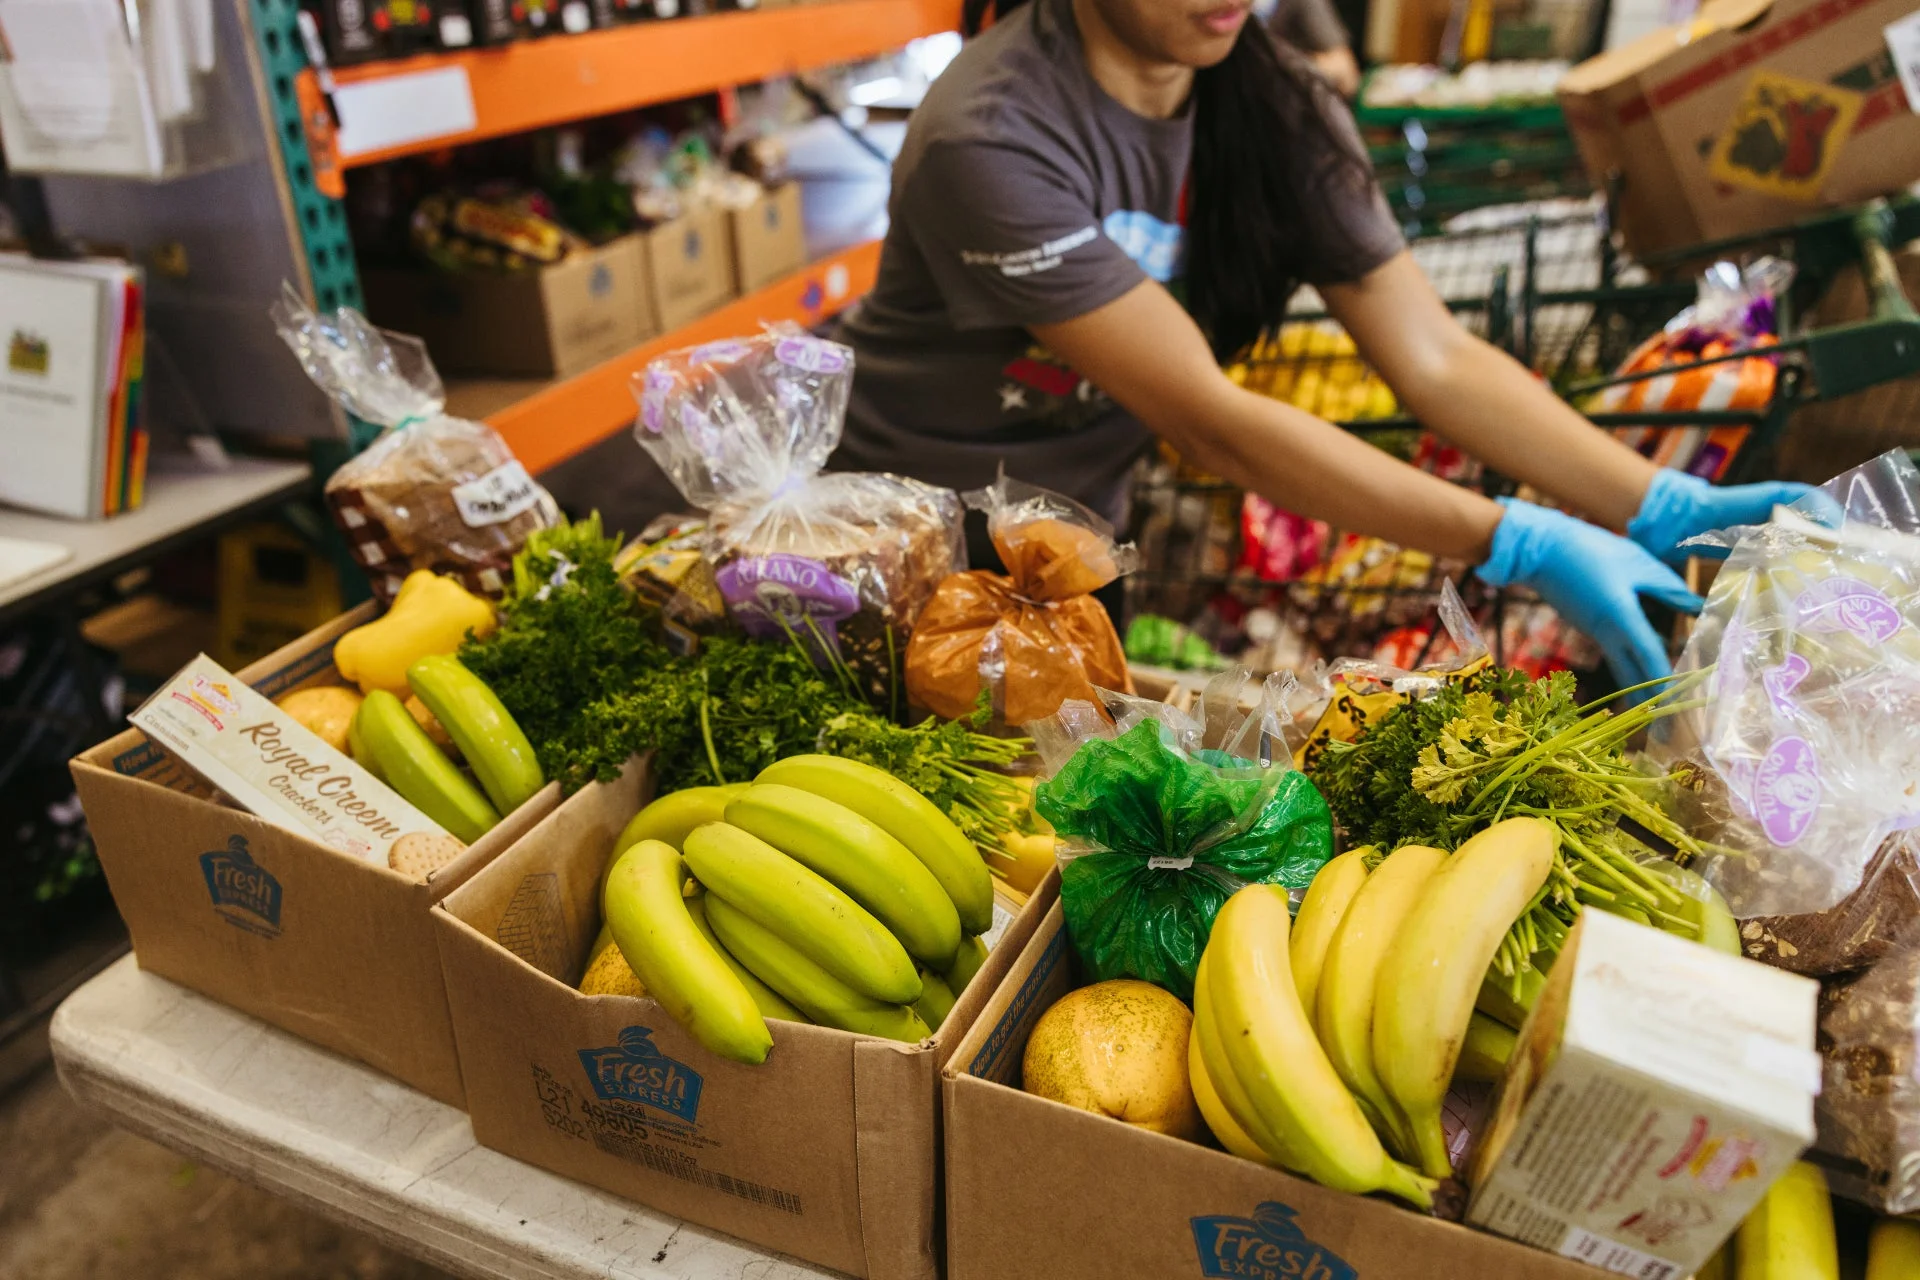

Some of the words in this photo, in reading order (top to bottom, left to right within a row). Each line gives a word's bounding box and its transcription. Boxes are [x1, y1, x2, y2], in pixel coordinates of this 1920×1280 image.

[239, 720, 332, 782] Royal
[317, 775, 401, 841] Creem
[268, 773, 335, 826] Crackers
[211, 857, 272, 905] Fresh
[973, 1046, 991, 1077] How
[991, 1036, 1000, 1052] to
[1000, 1016, 1014, 1044] get
[1013, 994, 1025, 1019] the
[1025, 969, 1042, 997] most
[592, 1053, 686, 1098] Fresh
[603, 1083, 682, 1110] EXPRESS
[1213, 1222, 1334, 1280] Fresh
[1219, 1259, 1290, 1280] EXPR
